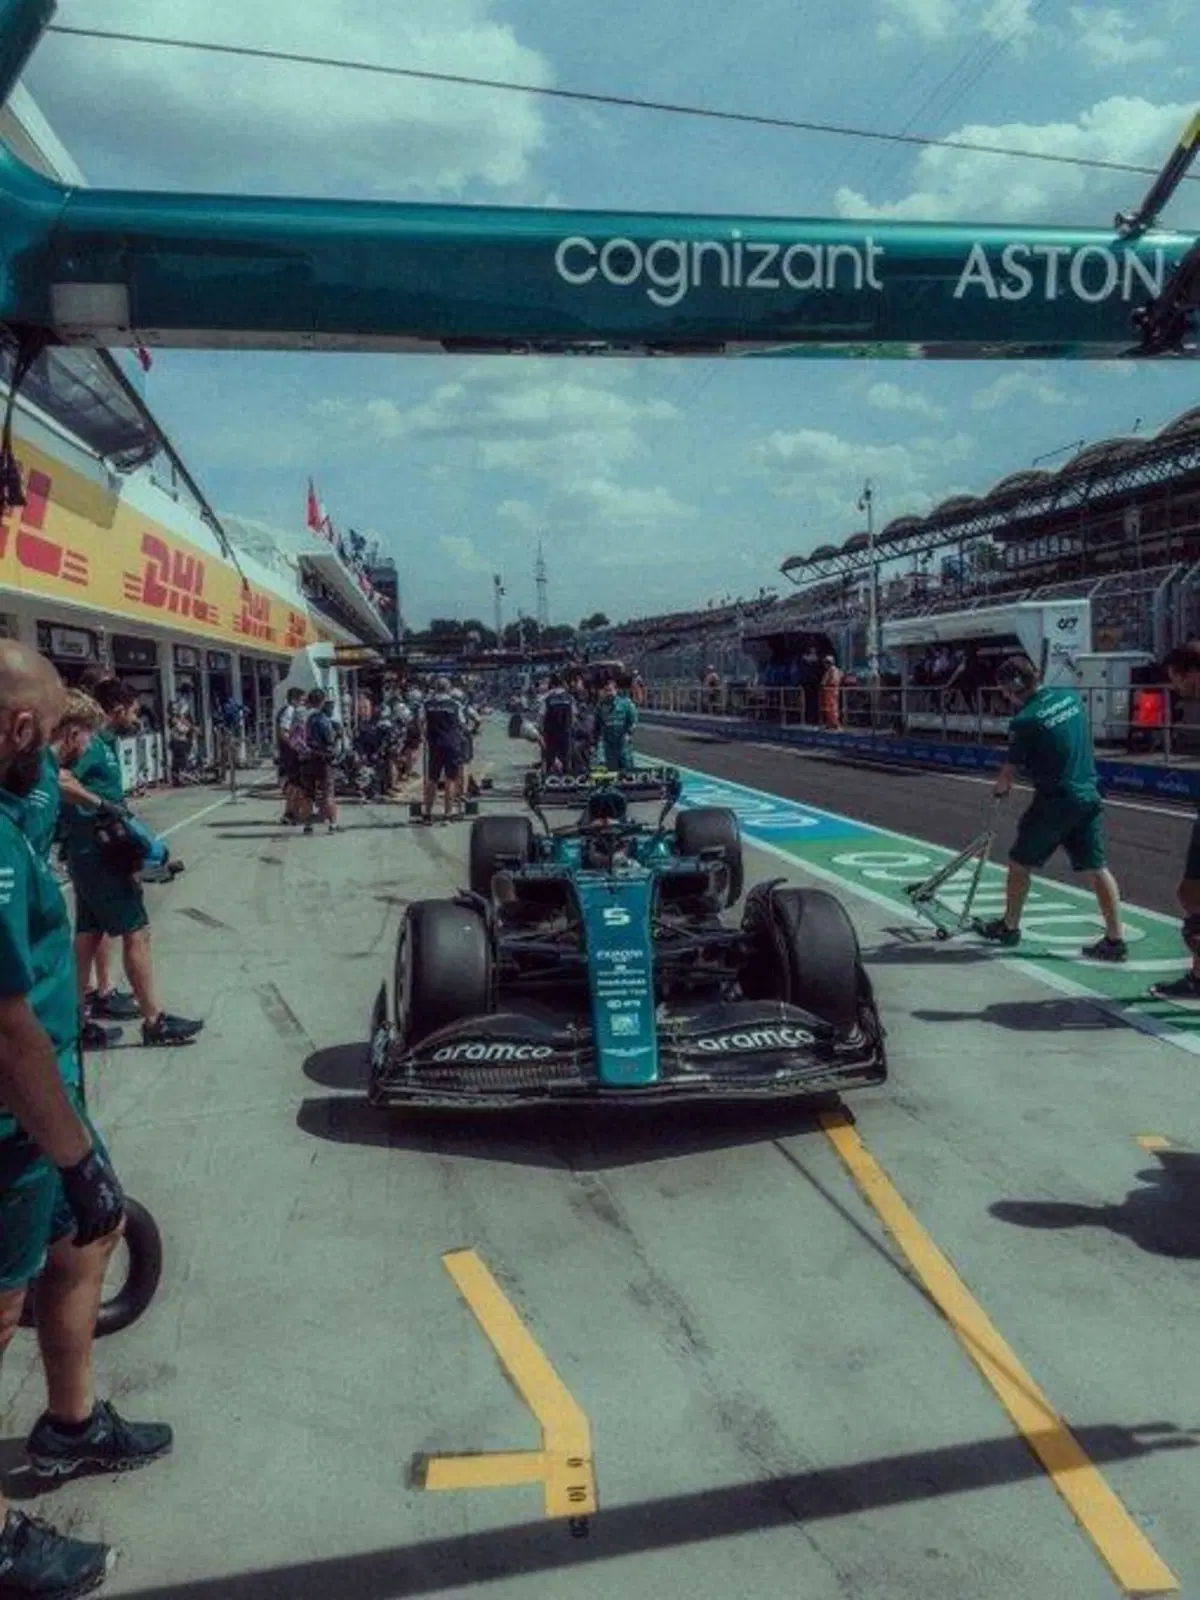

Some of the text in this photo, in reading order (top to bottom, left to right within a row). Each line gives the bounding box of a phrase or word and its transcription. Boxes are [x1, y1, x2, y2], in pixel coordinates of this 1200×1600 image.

[555, 229, 1165, 306] cognizant ASTON
[140, 532, 211, 624] DHL
[602, 907, 632, 926] 5
[697, 1028, 816, 1051] aramco
[432, 1043, 555, 1062] aramco
